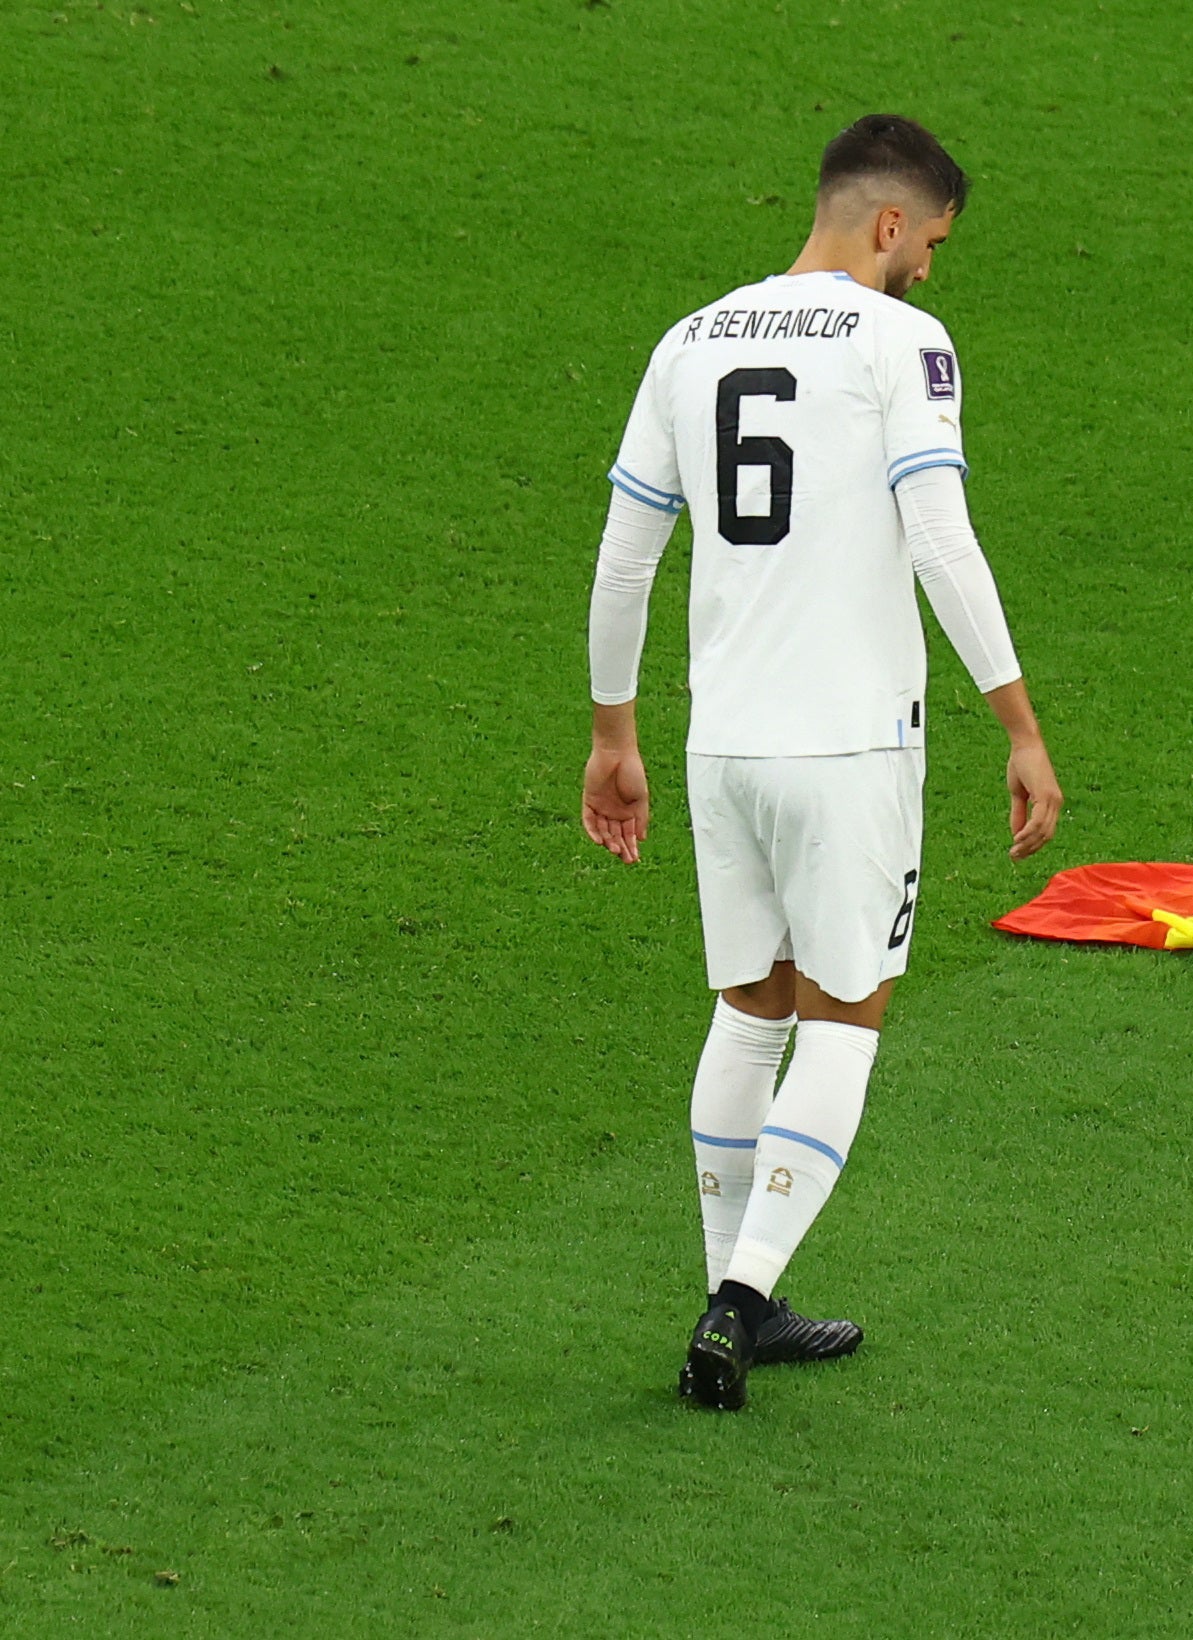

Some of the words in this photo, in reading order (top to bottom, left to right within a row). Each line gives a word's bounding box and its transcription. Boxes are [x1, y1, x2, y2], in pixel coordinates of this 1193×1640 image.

[708, 307, 860, 340] BENTANCUR
[715, 367, 797, 545] 6
[887, 867, 918, 950] 6
[703, 1330, 733, 1350] COPA
